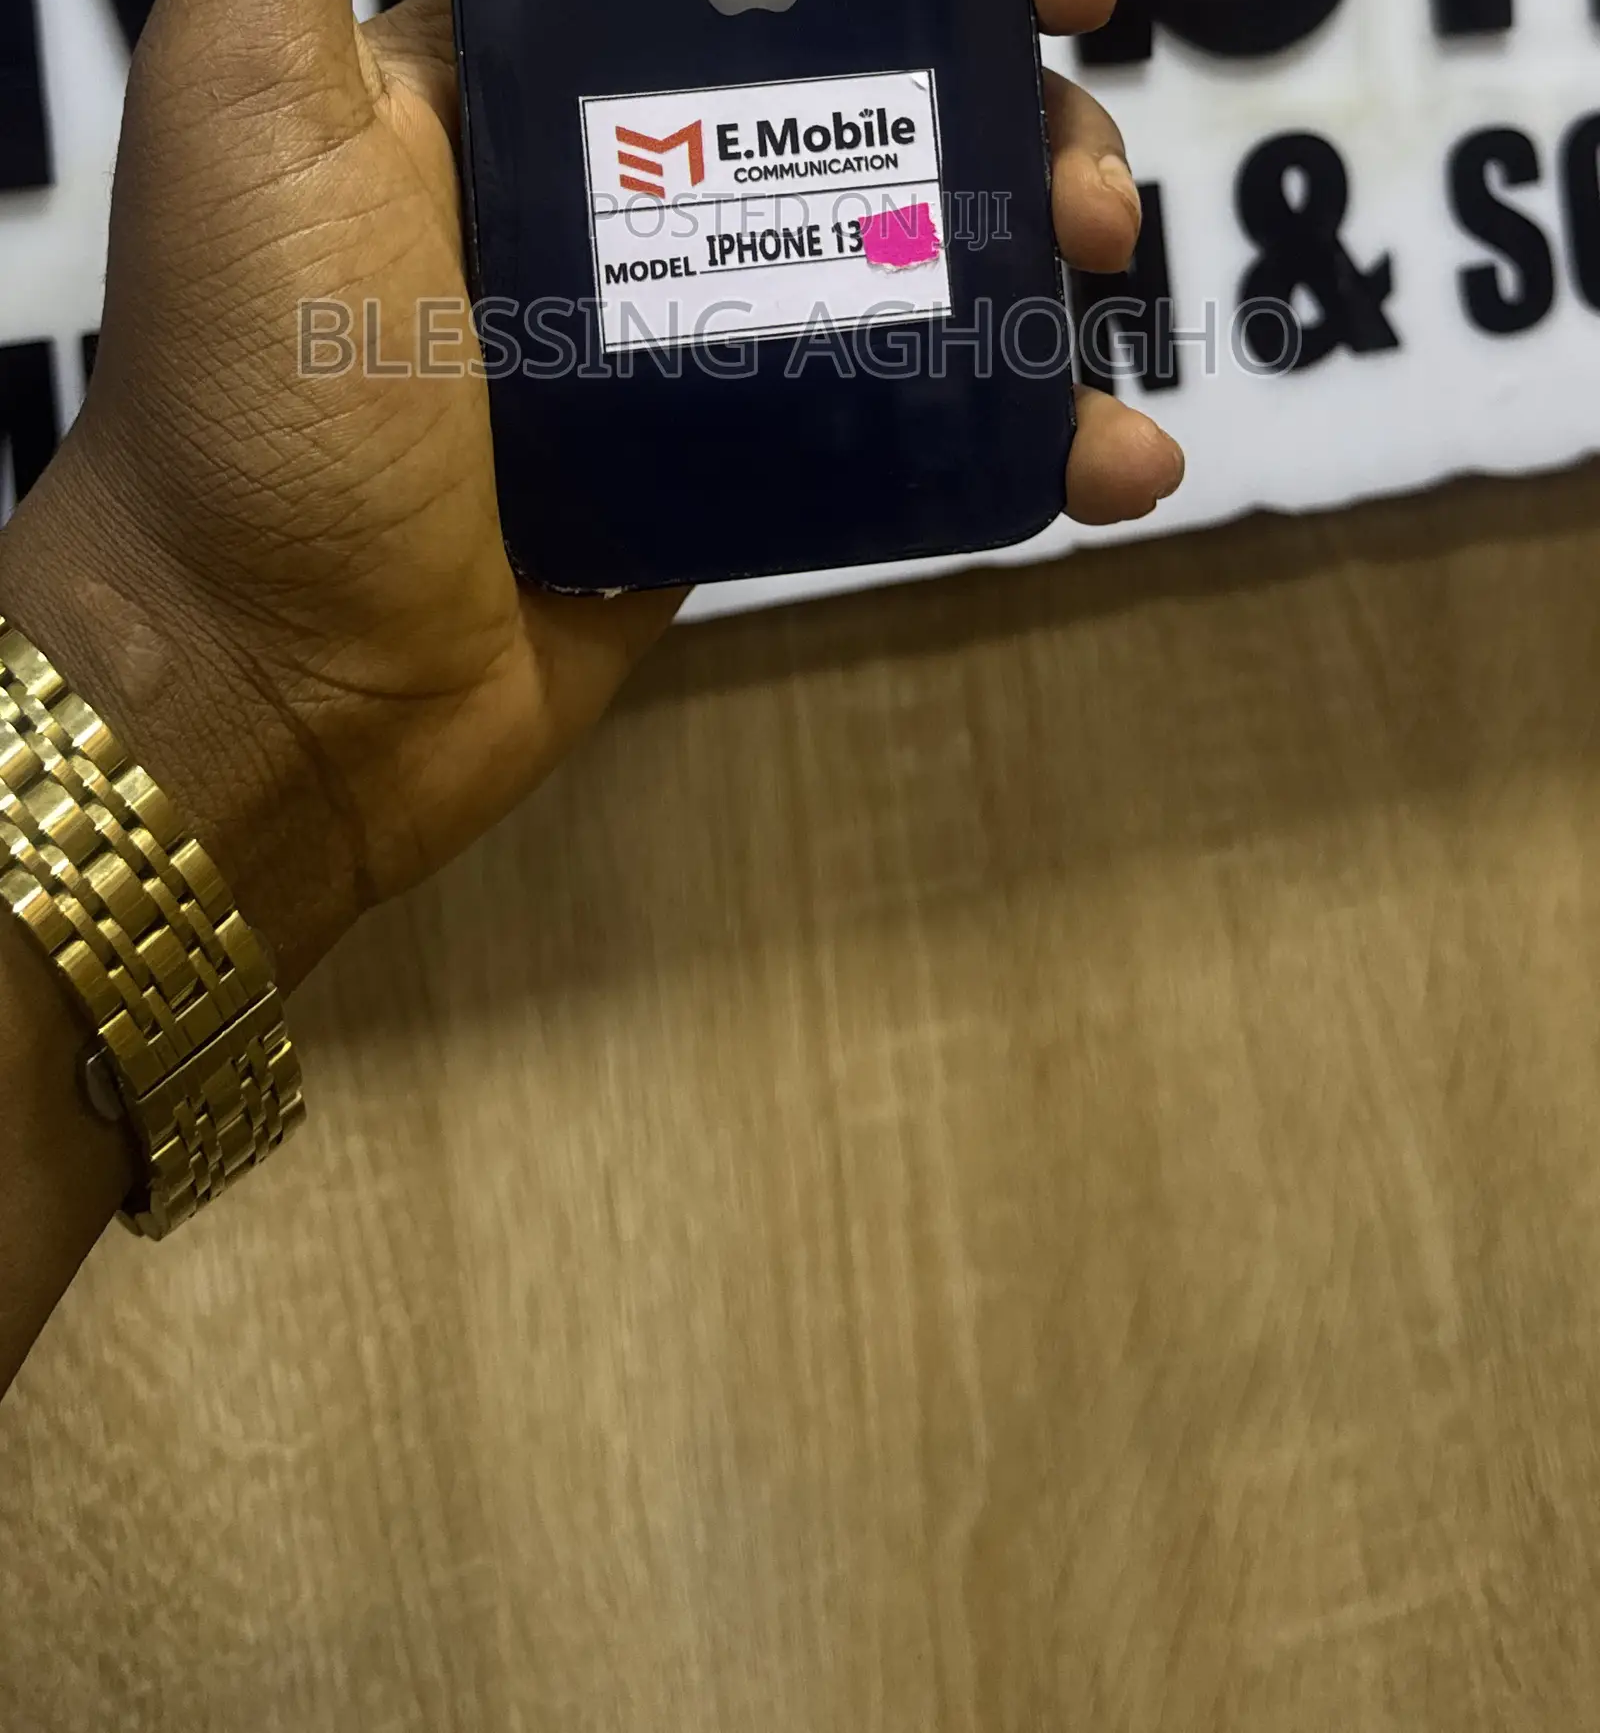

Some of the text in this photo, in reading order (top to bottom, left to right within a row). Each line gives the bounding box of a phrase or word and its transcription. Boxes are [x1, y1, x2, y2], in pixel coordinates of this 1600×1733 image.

[716, 107, 916, 162] E.Mobile
[733, 153, 899, 184] COMMUNICATION
[604, 219, 864, 285] MODEL IPHONE 13
